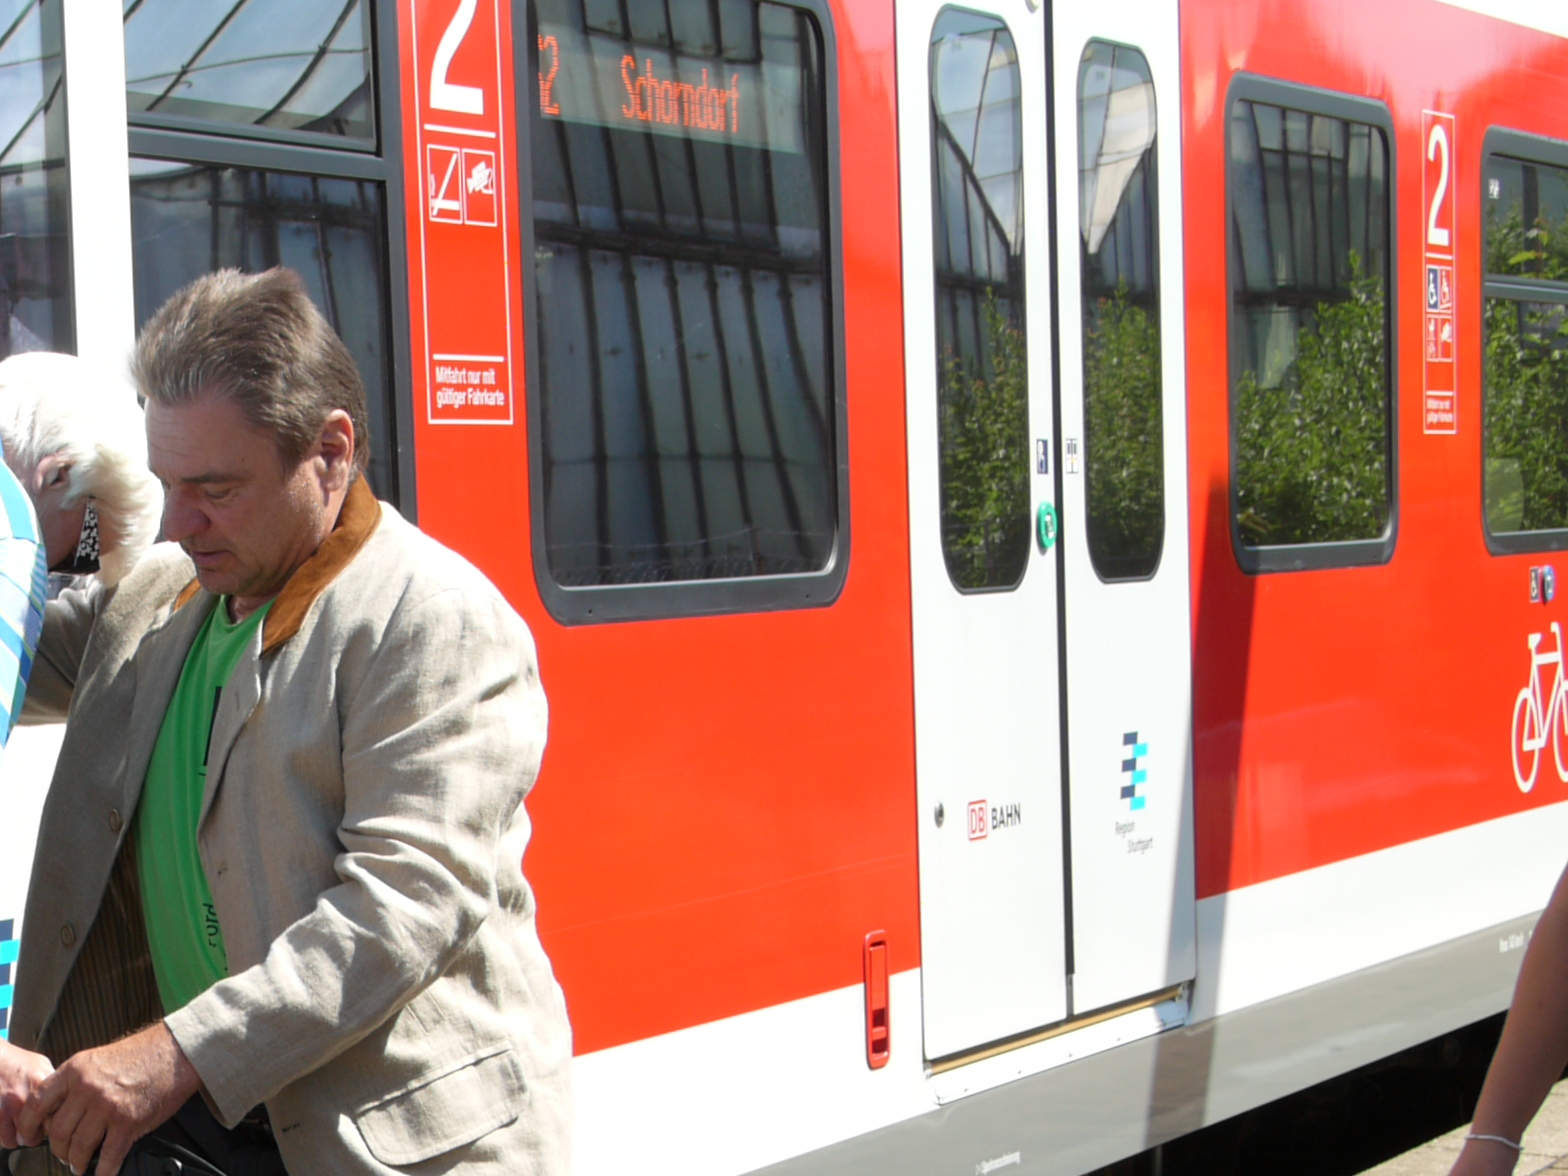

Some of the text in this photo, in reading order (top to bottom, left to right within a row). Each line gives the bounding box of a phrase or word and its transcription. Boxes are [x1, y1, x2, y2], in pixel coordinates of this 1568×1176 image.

[430, 0, 484, 116] 2
[621, 54, 739, 134] Schorndorf
[1428, 123, 1449, 247] 2
[435, 365, 496, 384] Mitfahrt nur mit
[467, 387, 505, 406] Fahrkarte
[970, 802, 1022, 835] DB BAHN
